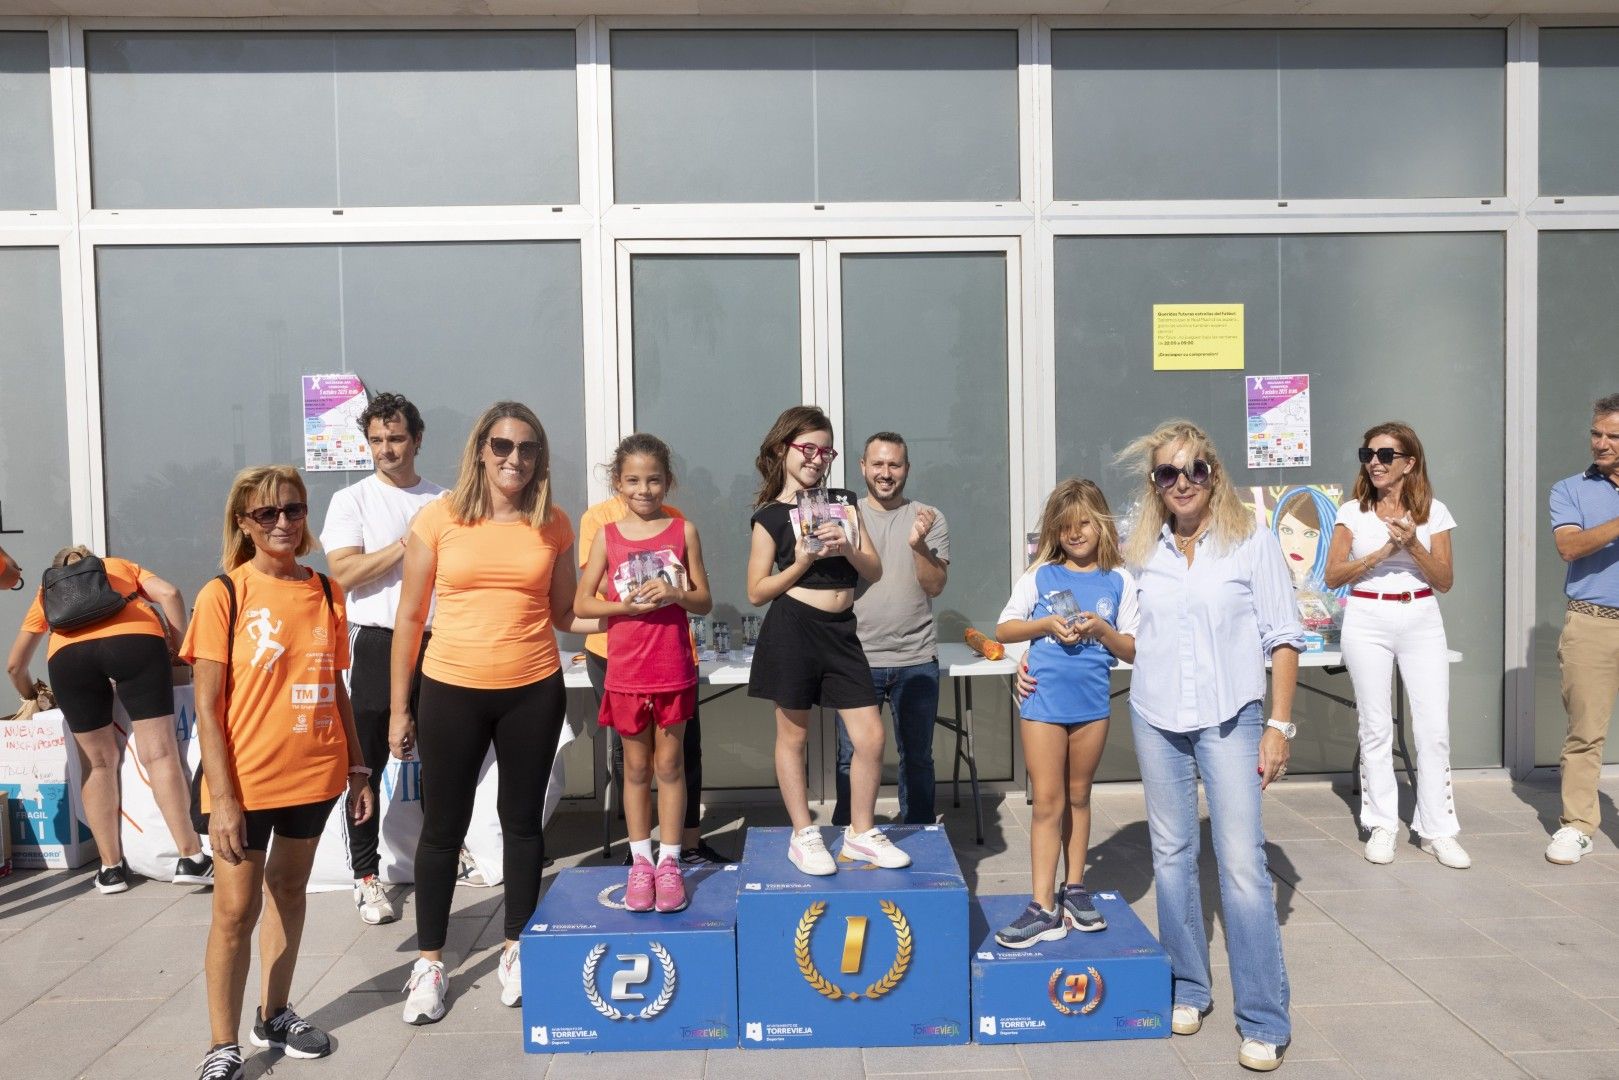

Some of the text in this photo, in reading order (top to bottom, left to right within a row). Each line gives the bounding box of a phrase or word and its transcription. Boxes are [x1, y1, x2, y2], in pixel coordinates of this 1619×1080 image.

[296, 690, 312, 699] TM
[841, 916, 868, 973] 1
[611, 954, 650, 1000] 2
[1063, 974, 1088, 1002] 3
[1114, 1016, 1162, 1029] TORREVIEJA
[680, 1026, 728, 1040] TORREVIEJA
[911, 1024, 960, 1037] TORREVIEJA
